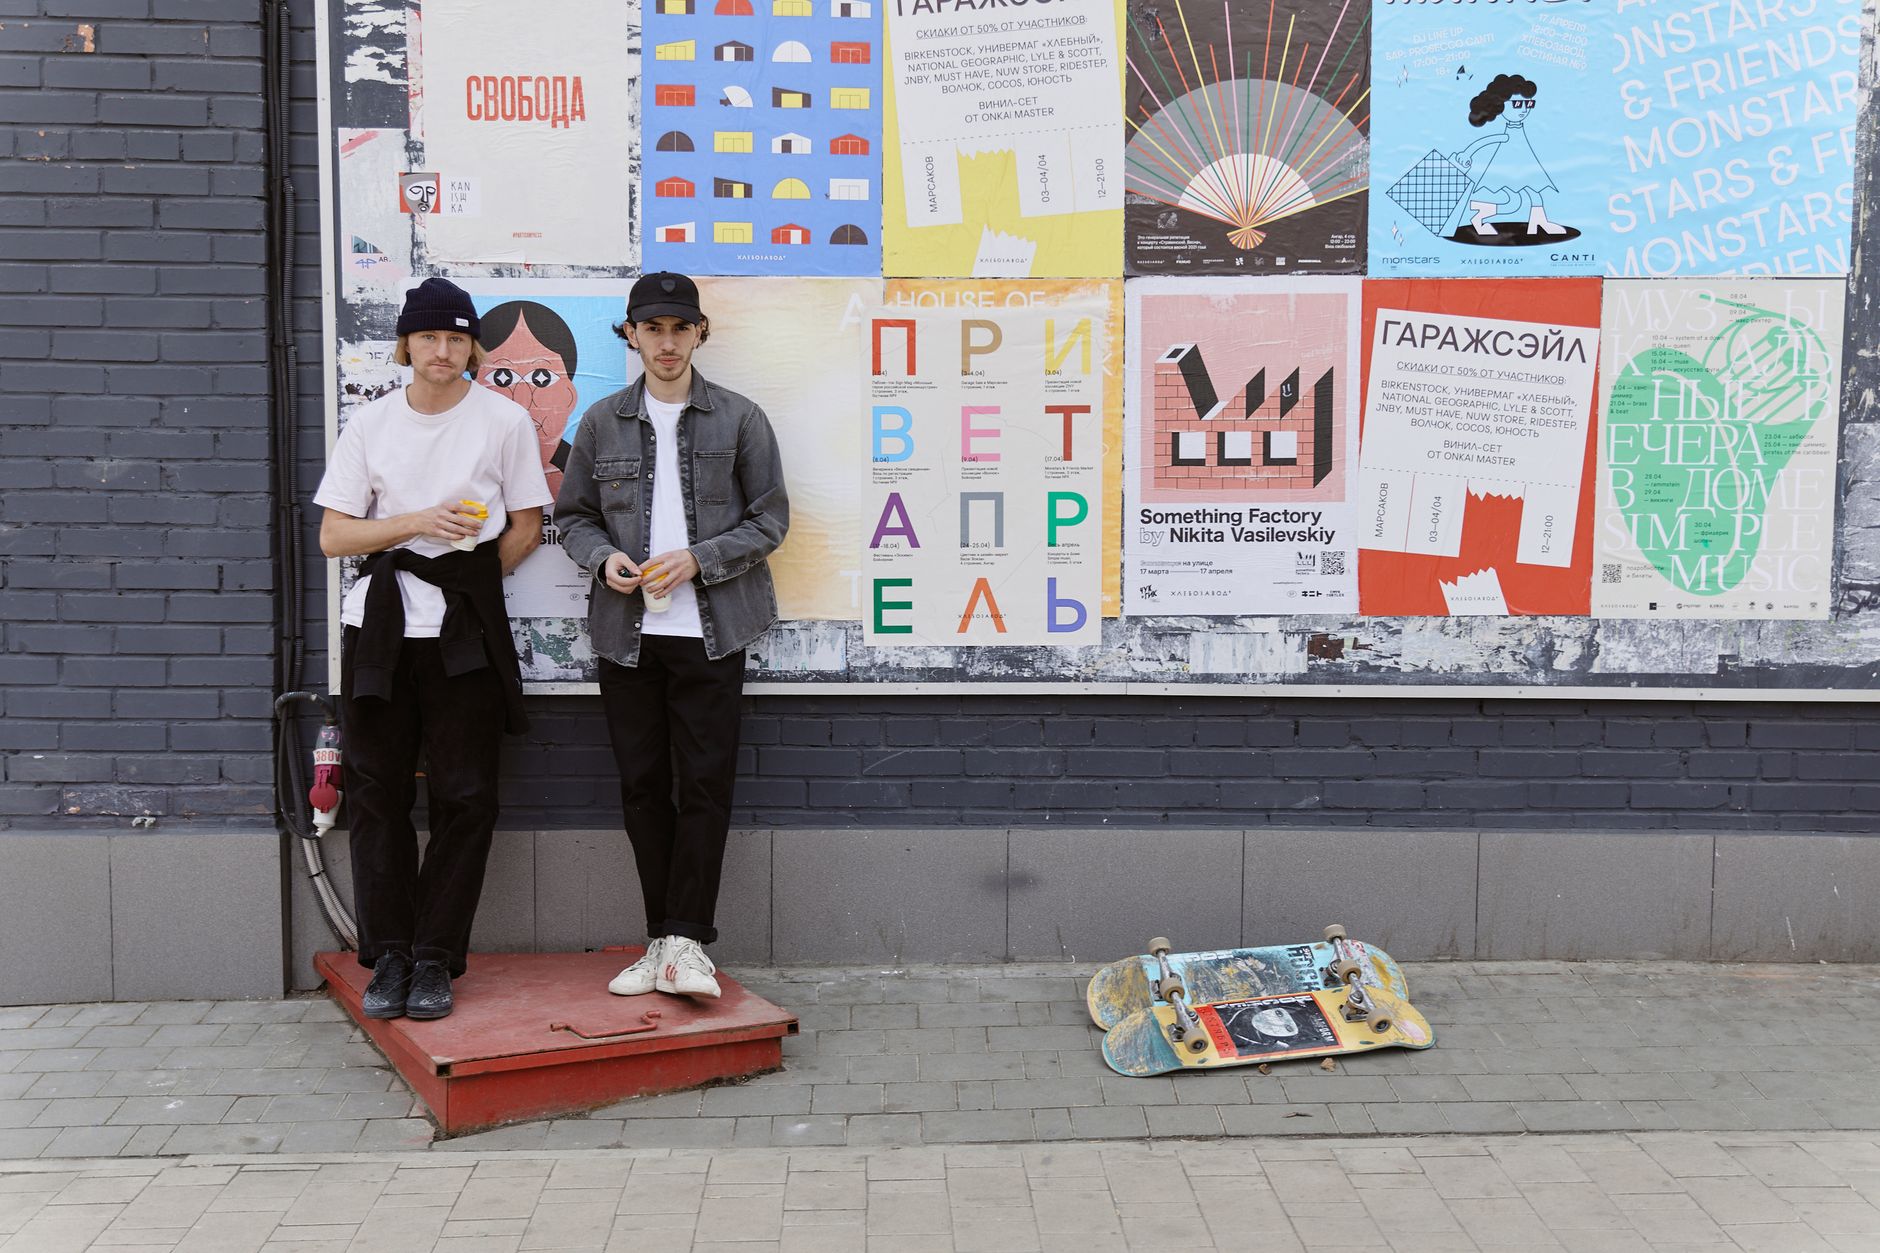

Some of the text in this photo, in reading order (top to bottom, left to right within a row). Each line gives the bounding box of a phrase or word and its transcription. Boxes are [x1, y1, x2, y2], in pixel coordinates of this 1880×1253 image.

[917, 16, 1087, 39] СКИДКИ ОТ 50% ОТ УЧАСТНИКОВ:
[905, 34, 1103, 60] BIRKENSTOCK, УНИВЕРМАГ «ХЛЕБНЫЙ»,
[908, 47, 1101, 73] NATIONAL GEOGRAPHIC, LYLE & SCOTT,
[904, 59, 1107, 86] JNBY, MUST HAVE, NUW STORE, RIDESTEP,
[1620, 15, 1861, 120] & FRIENDS
[942, 75, 1072, 94] ВОЛЧОК, COCOS, ЮНОСТЬ
[466, 76, 586, 128] СВОБОДА
[979, 97, 1038, 110] ВИНИЛ-СЕТ
[965, 108, 1054, 123] ОТ ONKAI MASTER
[925, 156, 938, 213] МАРСАКОВ
[1608, 146, 1799, 233] STARS &
[1382, 255, 1440, 264] monstars
[1382, 320, 1587, 363] ГАРАЖСЭЙЛ
[1396, 361, 1566, 385] СКИДКИ ОТ 50% ОТ УЧАСТНИКОВ:
[1381, 380, 1577, 406] BIRKENSTOCK, УНИВЕРМАГ «ХЛЕБНЫЙ»,
[1382, 392, 1573, 418] NATIONAL GEOGRAPHIC, LYLE & SCOTT,
[1376, 403, 1578, 430] JNBY, MUST HAVE, NUW STORE, RIDESTEP,
[1411, 418, 1539, 438] ВОЛЧОК, COCOS, ЮНОСТЬ
[1427, 451, 1515, 466] ОТ ONKAI MASTER
[1444, 440, 1503, 453] ВИНИЛ-СЕТ
[1606, 468, 1824, 518] В ДОМЕ
[1140, 509, 1322, 526] Something Factory
[1375, 483, 1389, 538] МАРСАКОВ
[1140, 527, 1335, 547] by Nikita Vasilevskiy
[1664, 554, 1819, 592] MUSIC
